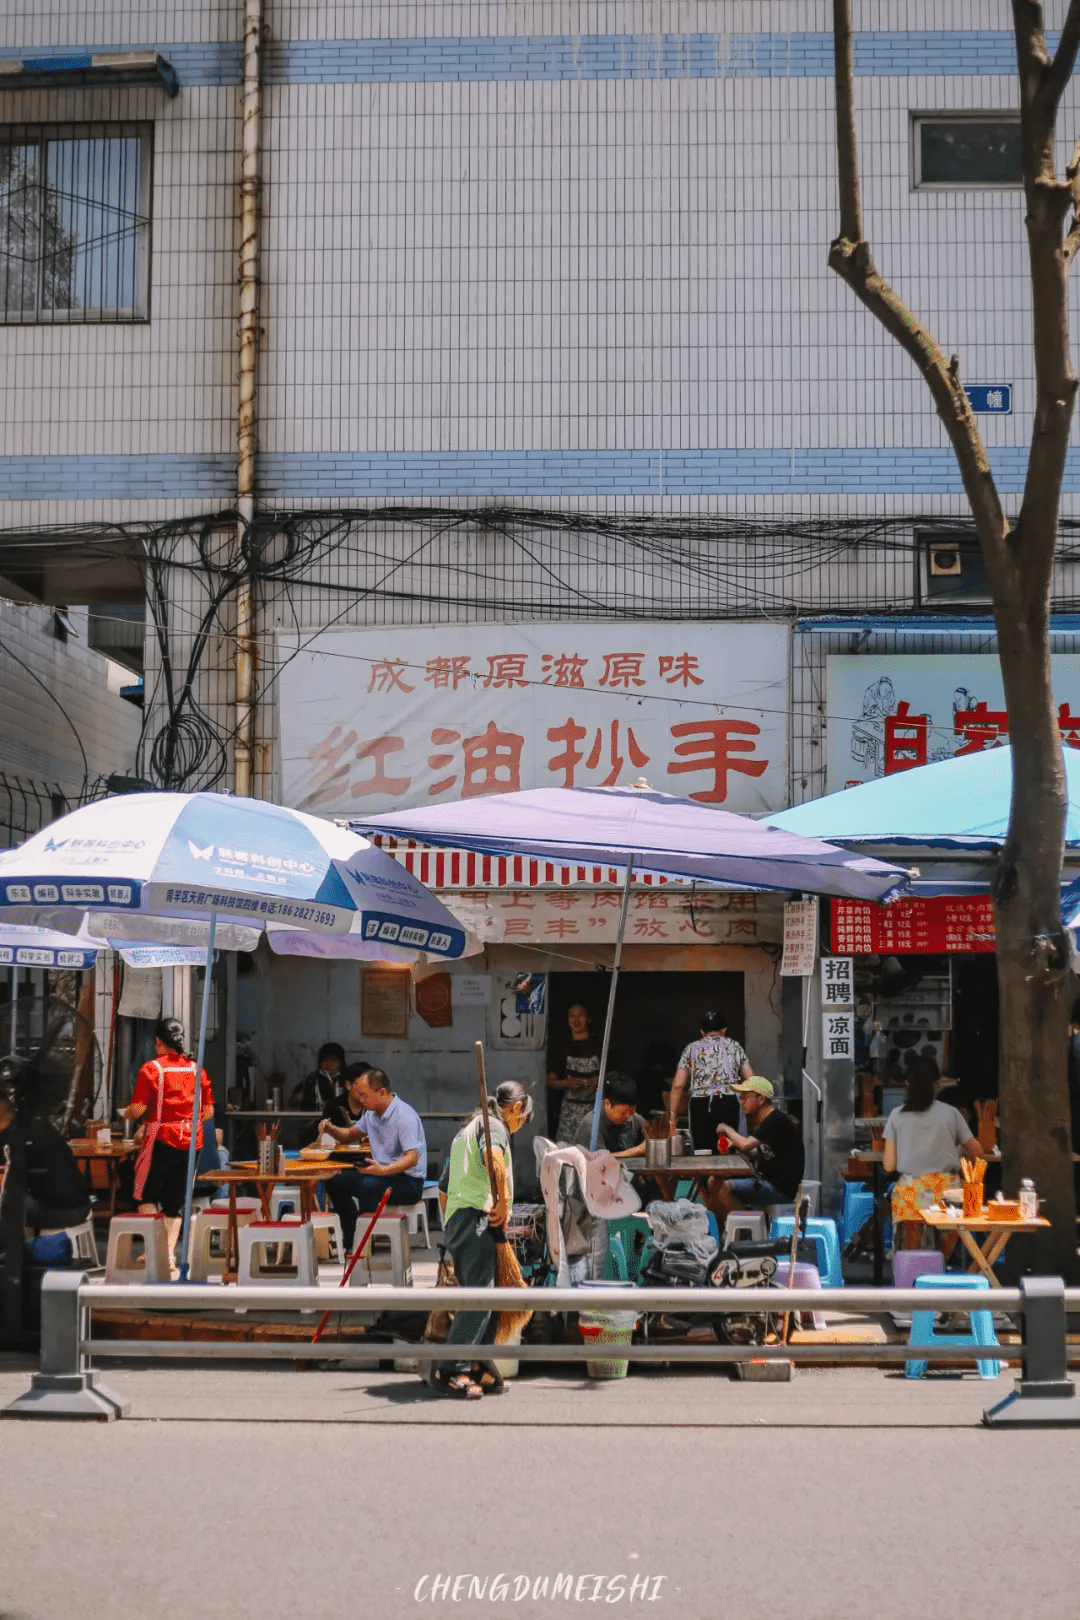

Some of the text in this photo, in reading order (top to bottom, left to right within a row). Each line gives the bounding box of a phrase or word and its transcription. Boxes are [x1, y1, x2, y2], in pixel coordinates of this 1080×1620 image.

[367, 653, 705, 694] 成都原滋原味
[309, 717, 769, 803] 红油抄手
[65, 888, 101, 898] 科学实验
[110, 889, 129, 900] 机器人
[293, 905, 314, 920] 2827
[315, 910, 336, 927] 3693
[825, 960, 851, 1003] 招聘
[829, 1016, 850, 1055] 凉面
